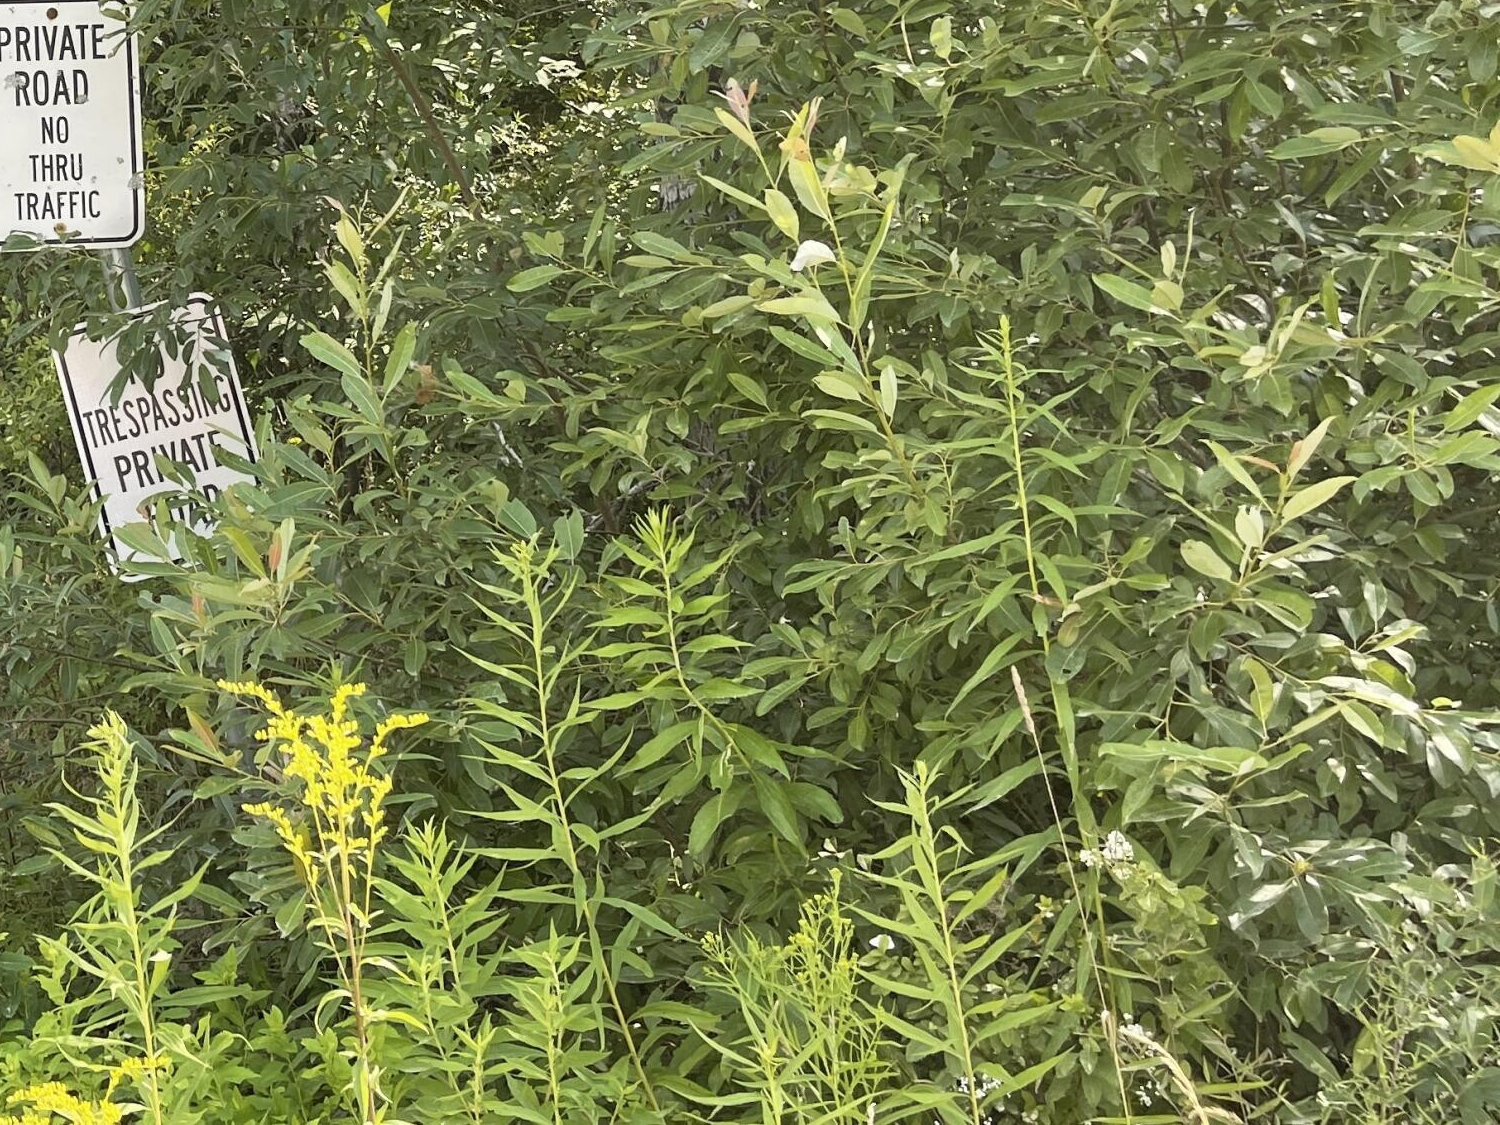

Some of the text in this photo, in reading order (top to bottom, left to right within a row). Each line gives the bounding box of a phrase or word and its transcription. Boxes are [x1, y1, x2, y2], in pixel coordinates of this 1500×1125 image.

[14, 69, 90, 107] ROAD
[41, 116, 69, 144] NO
[29, 153, 83, 182] THRU
[14, 190, 101, 221] TRAFFIC
